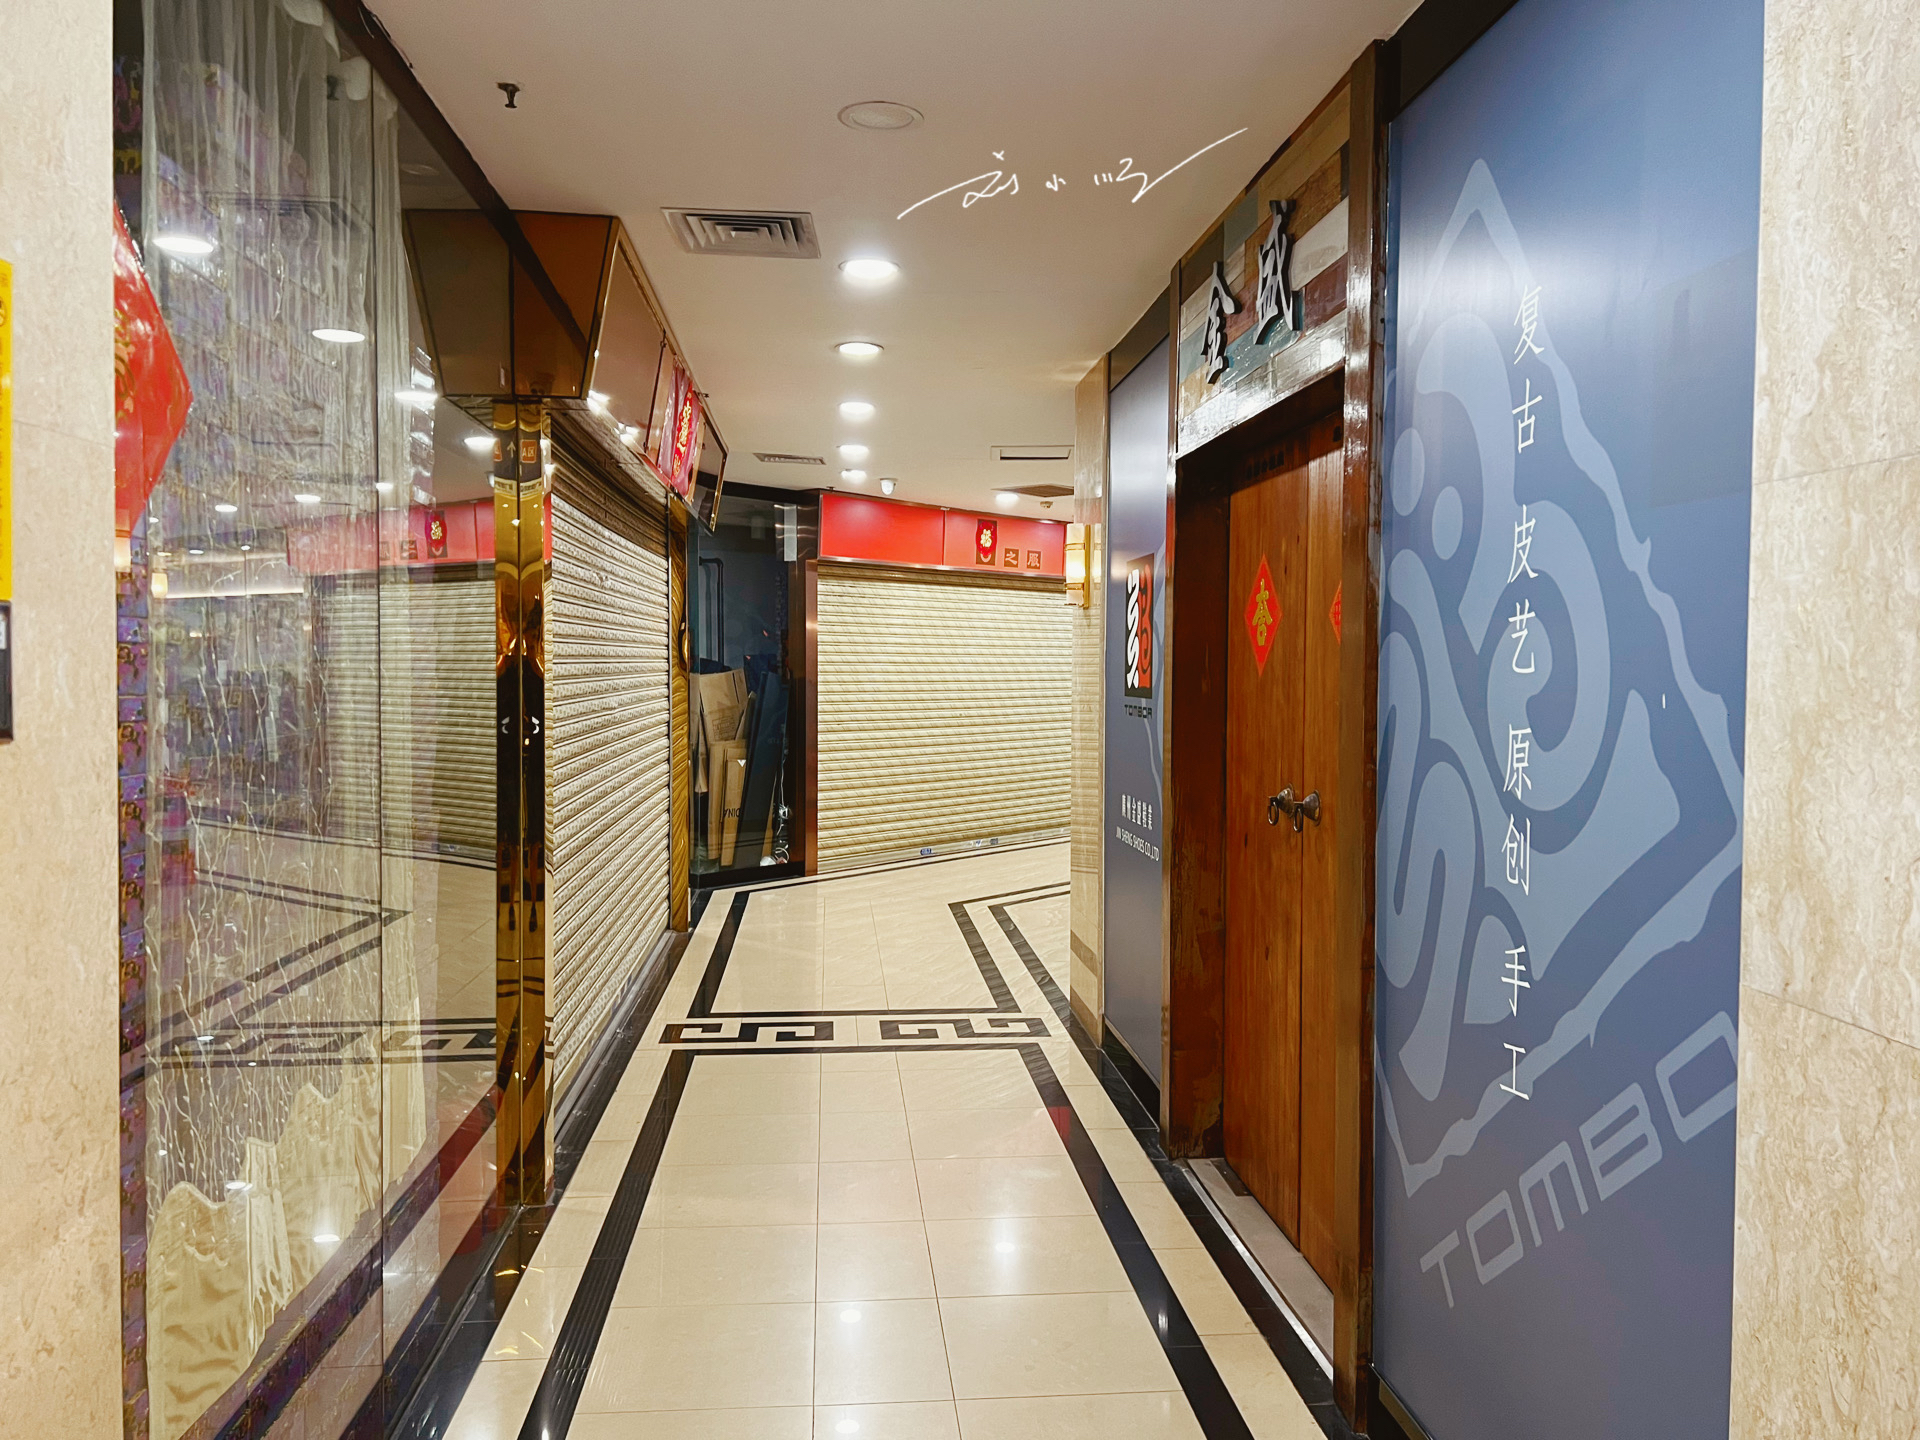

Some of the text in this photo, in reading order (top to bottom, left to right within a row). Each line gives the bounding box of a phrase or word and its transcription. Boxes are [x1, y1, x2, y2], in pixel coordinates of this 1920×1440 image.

[1500, 284, 1544, 1100] 复古 皮艺 原创 手工
